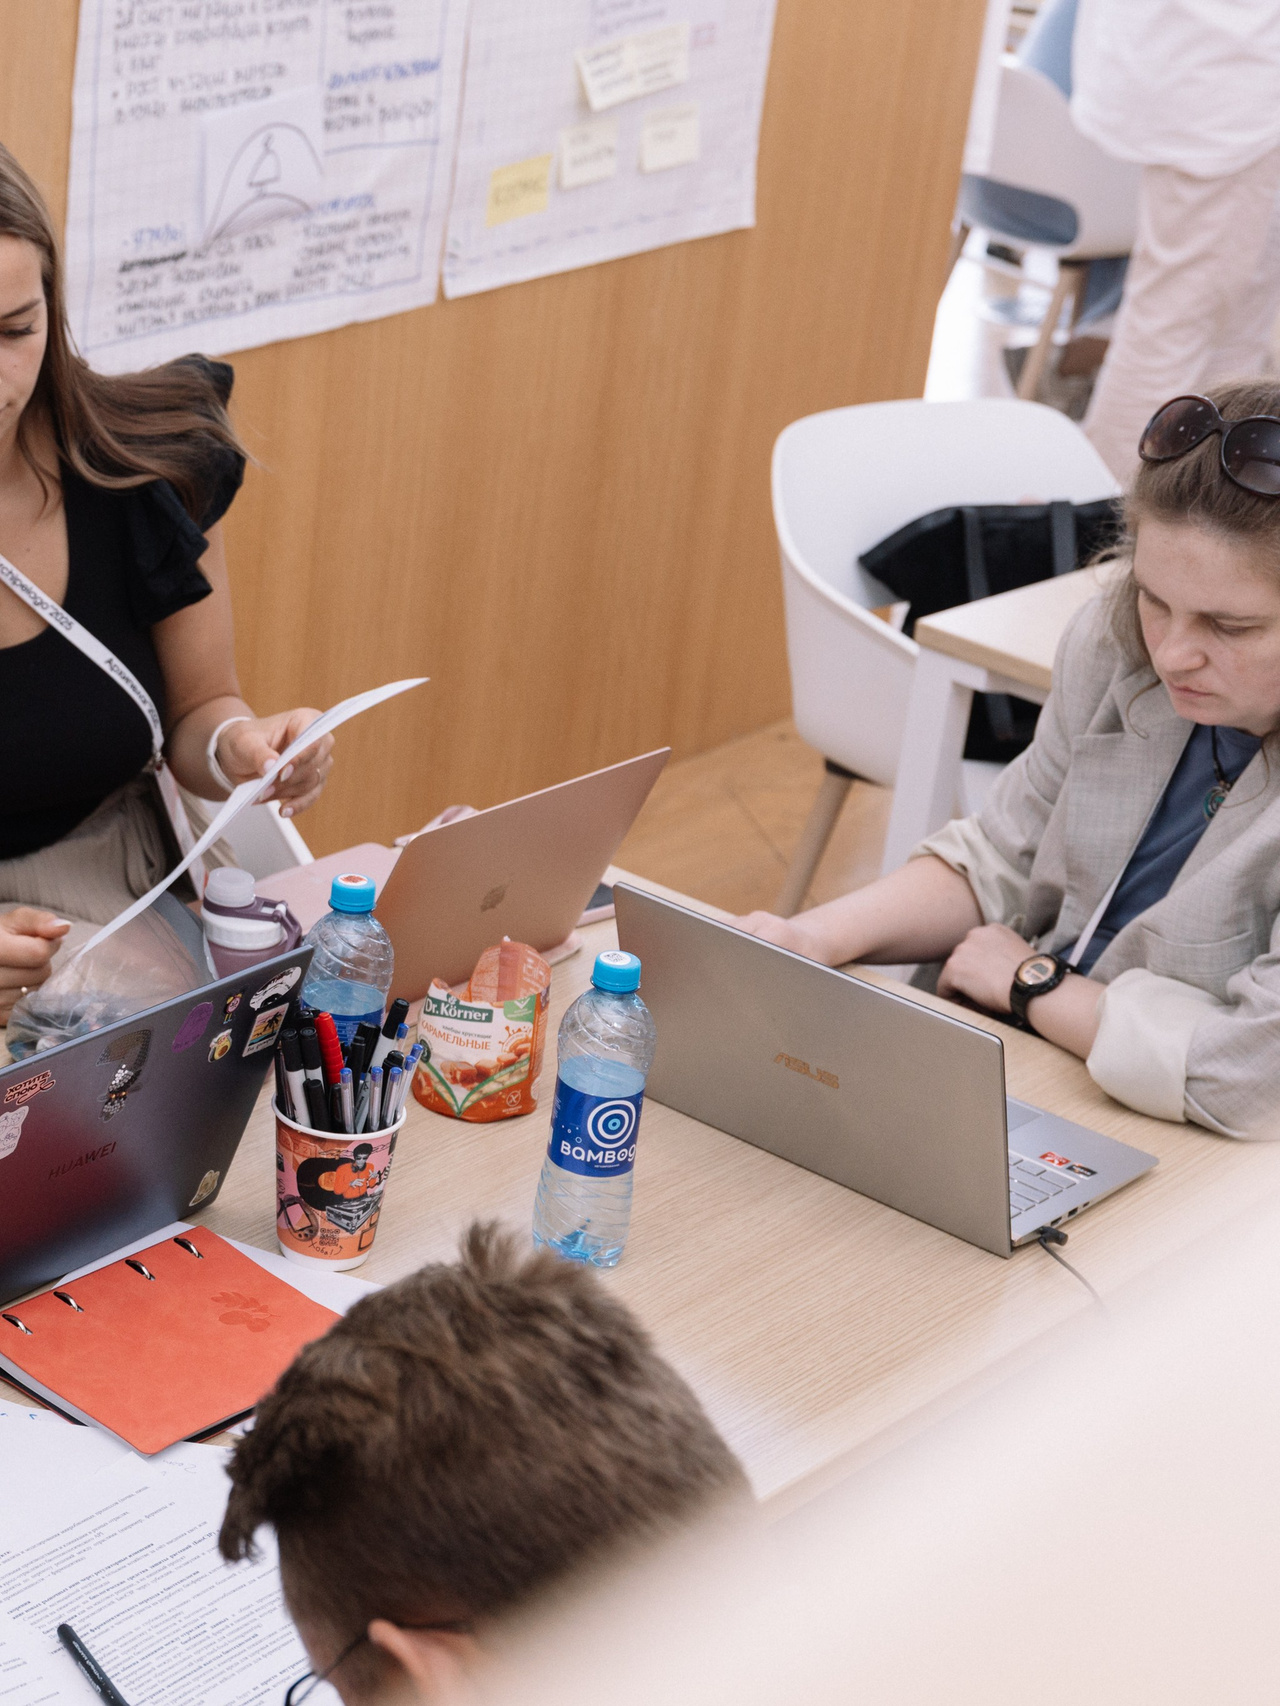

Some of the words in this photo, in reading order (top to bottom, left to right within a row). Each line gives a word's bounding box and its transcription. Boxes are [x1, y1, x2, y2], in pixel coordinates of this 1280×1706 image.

[425, 998, 439, 1014] Dr.
[440, 1004, 488, 1021] Körner
[774, 1052, 839, 1089] ASUS
[48, 1141, 117, 1180] HUAWEI
